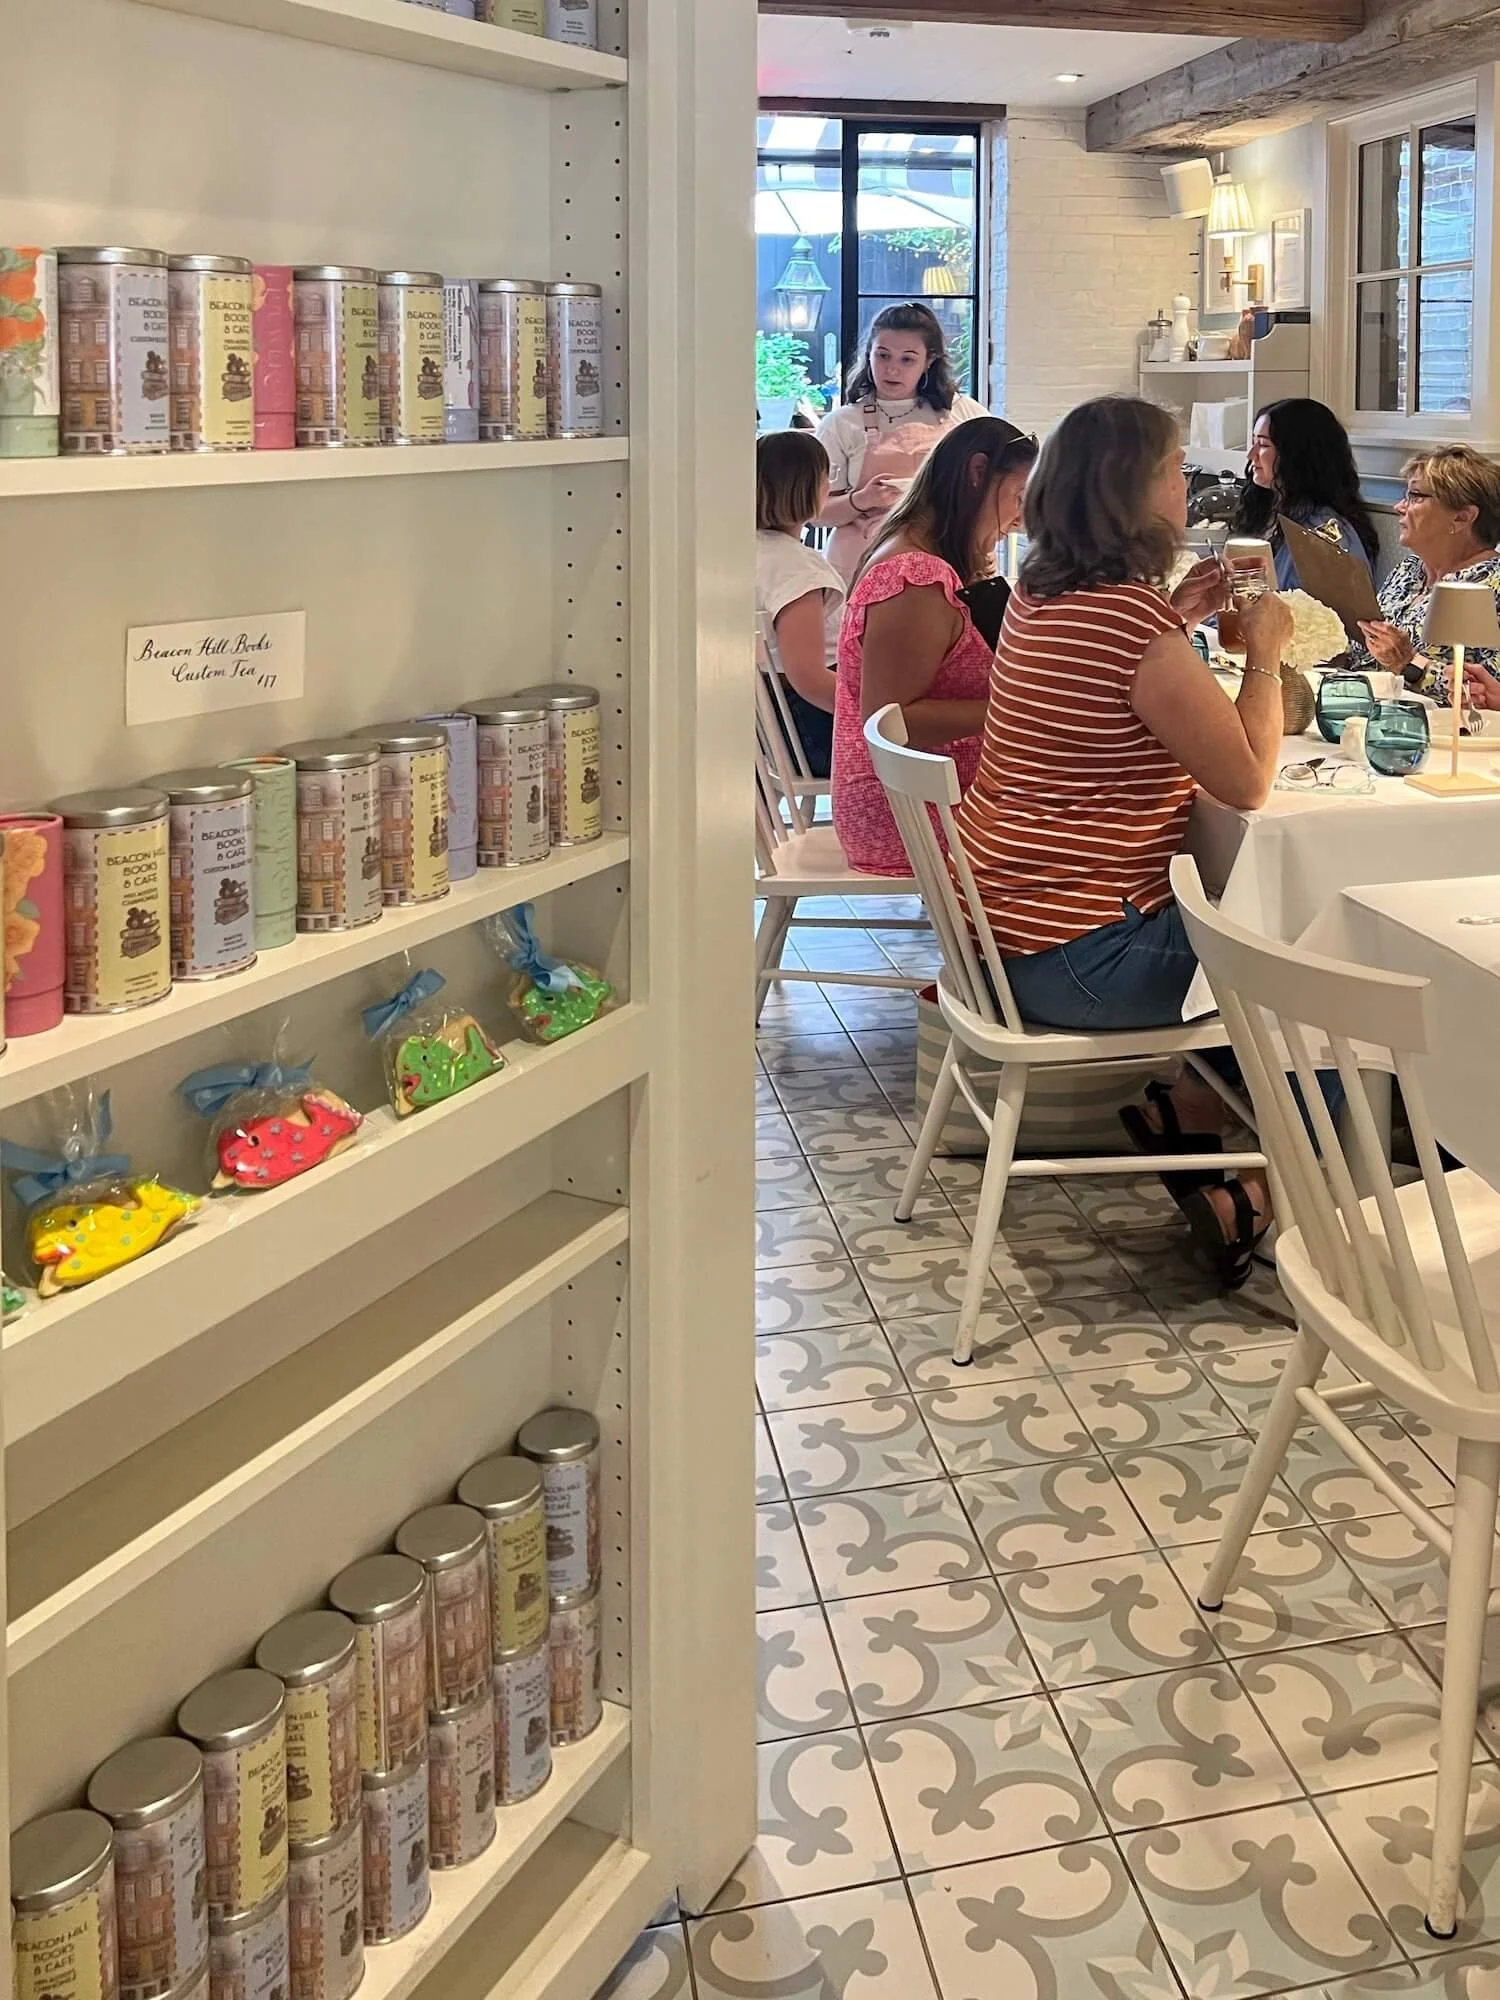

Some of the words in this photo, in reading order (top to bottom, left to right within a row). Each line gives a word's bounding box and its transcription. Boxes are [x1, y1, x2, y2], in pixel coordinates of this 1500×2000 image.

[133, 639, 192, 662] Beacon
[195, 636, 230, 657] Hill
[230, 633, 273, 655] Books
[171, 662, 225, 683] Custom
[229, 659, 256, 678] Tea
[202, 829, 240, 841] BEACON
[107, 852, 151, 866] BEACON
[16, 1934, 65, 1953] BEACON
